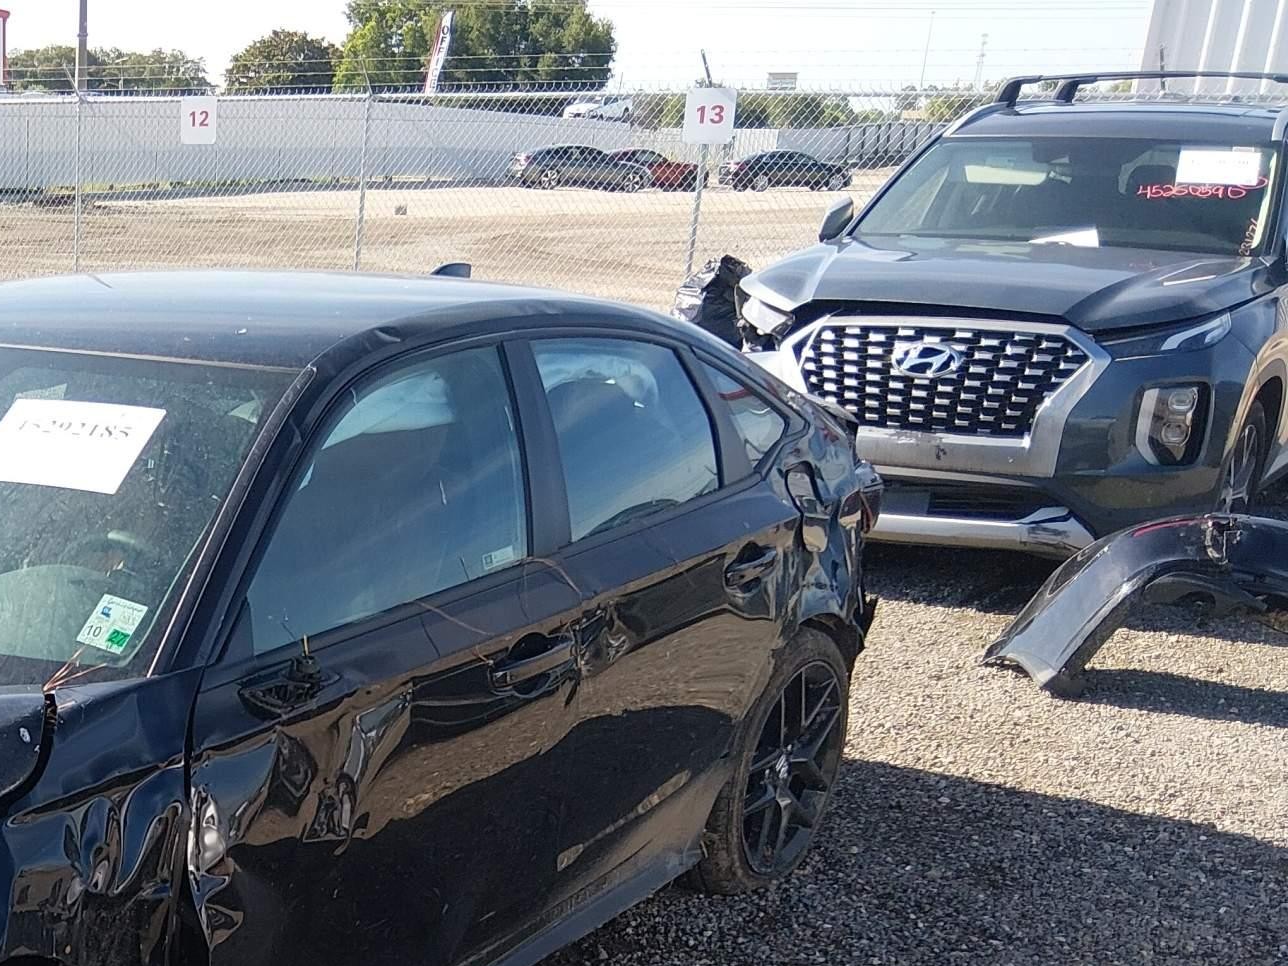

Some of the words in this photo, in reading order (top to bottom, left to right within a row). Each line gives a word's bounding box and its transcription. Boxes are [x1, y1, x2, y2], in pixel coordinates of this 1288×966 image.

[189, 110, 209, 128] 12
[696, 104, 725, 125] 13
[86, 624, 102, 637] 10
[108, 629, 131, 647] 27
